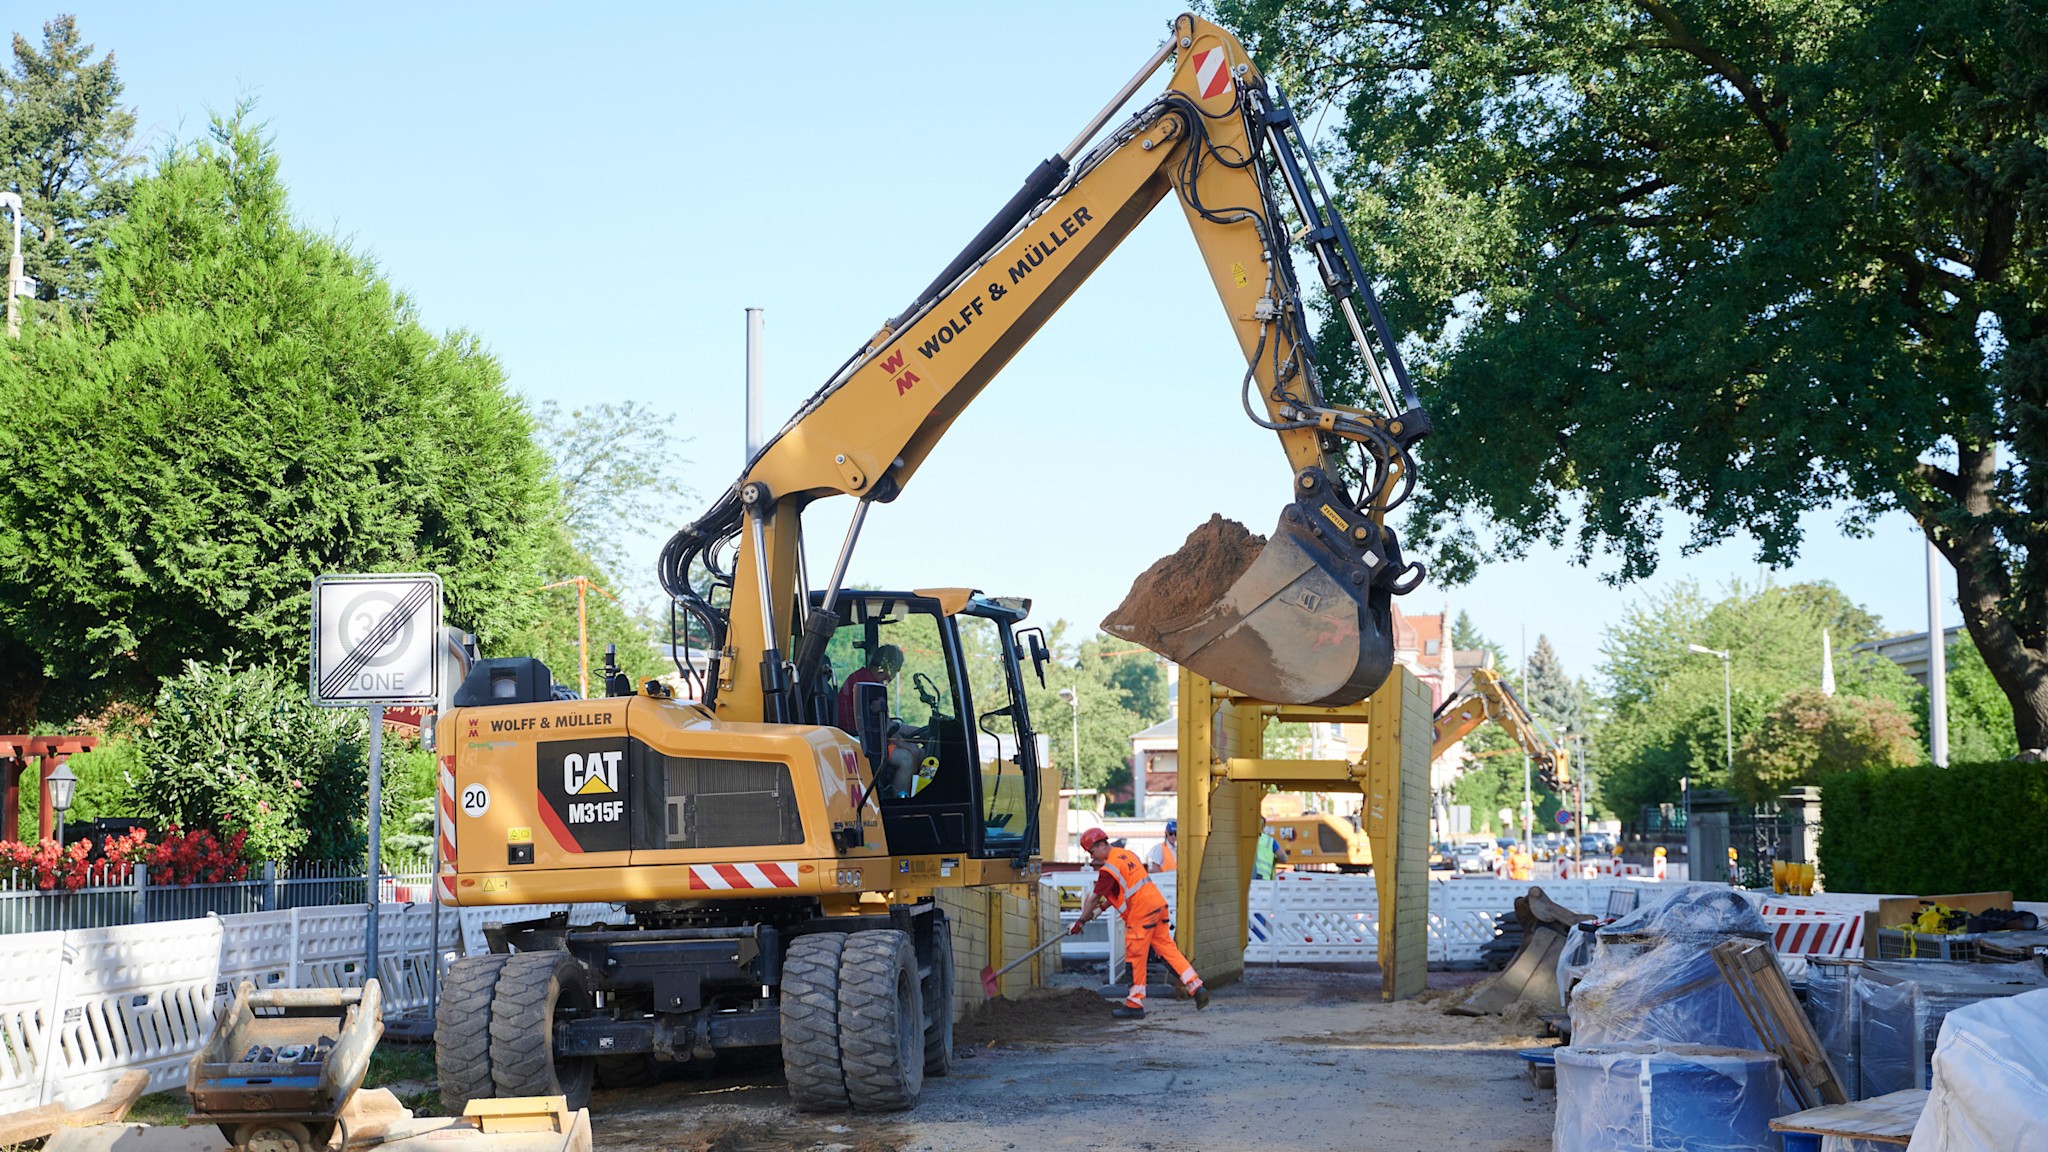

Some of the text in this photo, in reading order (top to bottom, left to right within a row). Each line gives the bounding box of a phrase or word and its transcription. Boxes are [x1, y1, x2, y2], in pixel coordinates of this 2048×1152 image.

[917, 206, 1093, 359] WOLFF & MÜLLER
[1323, 507, 1346, 529] ZEPPELIN
[348, 673, 405, 691] ZONE
[491, 712, 612, 732] WOLFF & MÜLLER
[564, 751, 622, 795] CAT
[465, 790, 486, 809] 20
[569, 801, 623, 824] M315F
